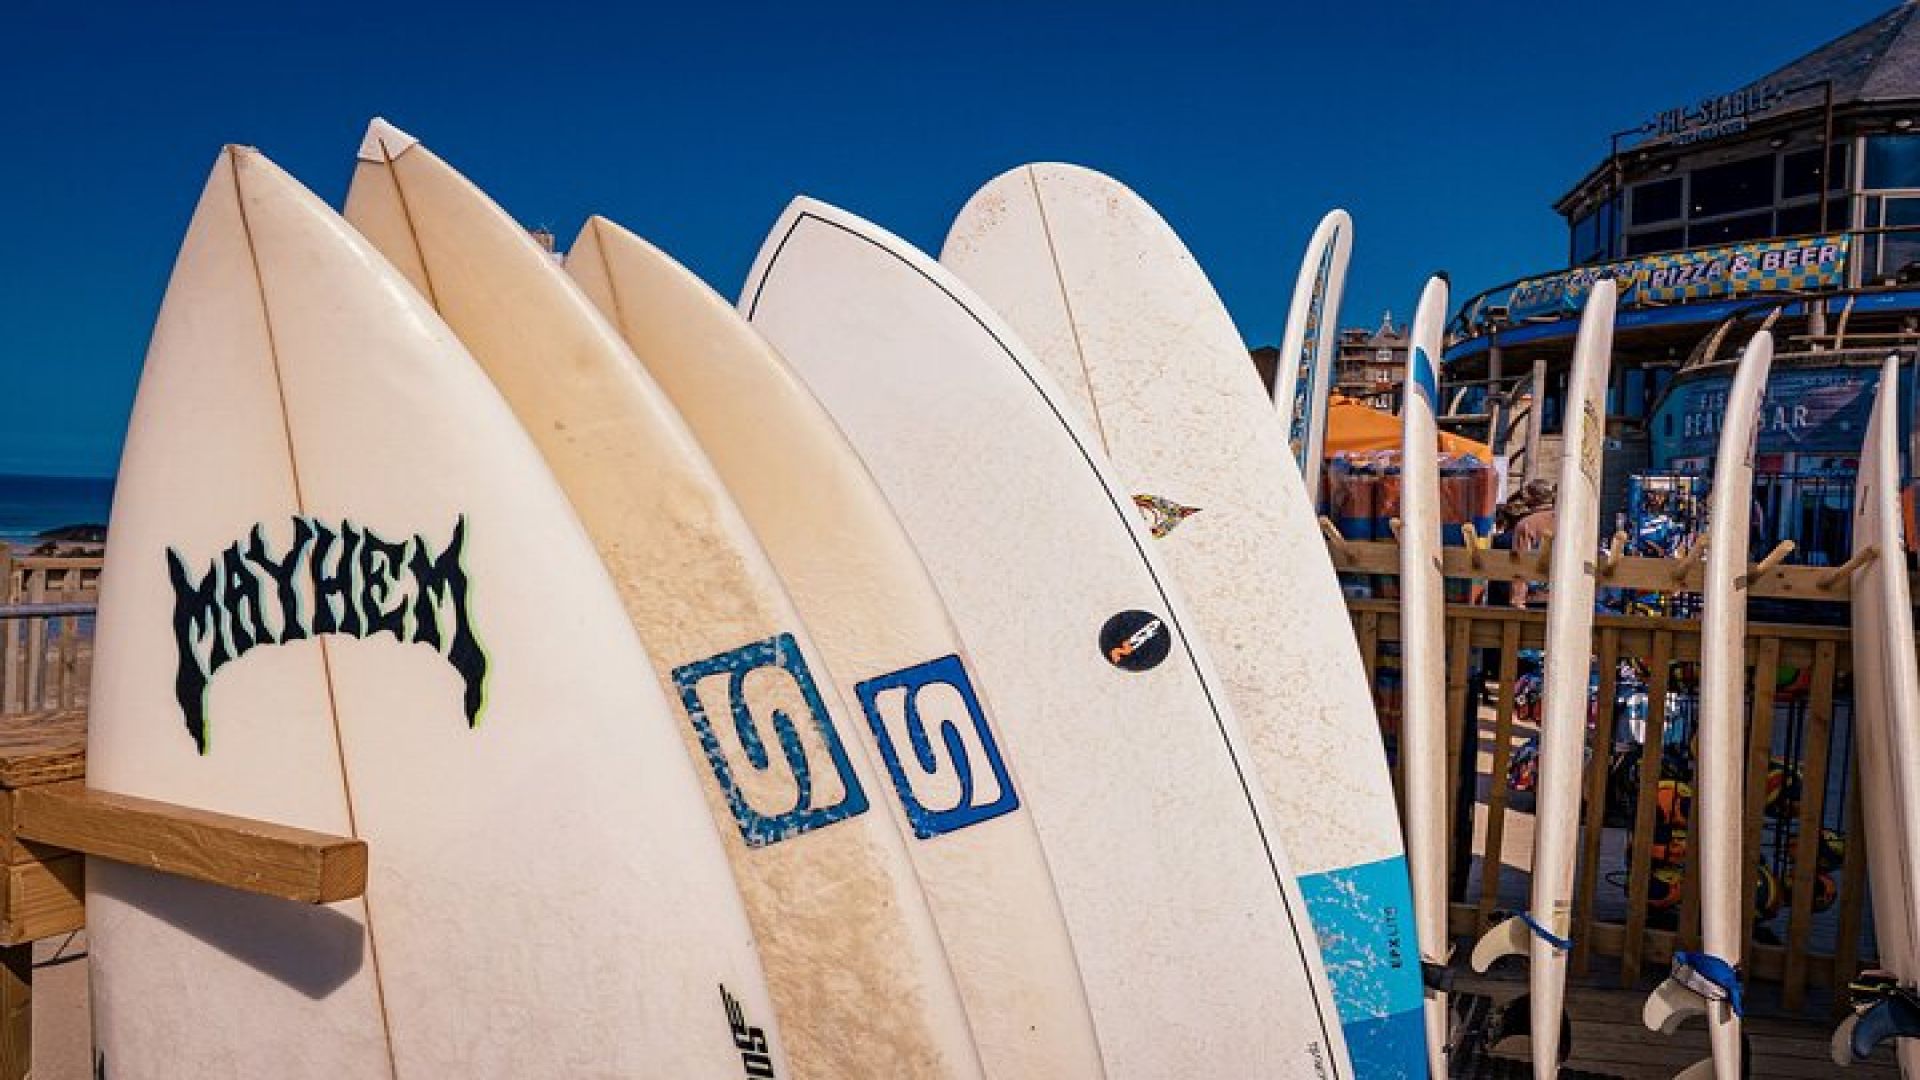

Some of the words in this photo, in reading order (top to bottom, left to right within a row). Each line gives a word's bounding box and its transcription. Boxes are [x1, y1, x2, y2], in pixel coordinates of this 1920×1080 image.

[1651, 260, 1722, 289] PIZZA
[1731, 250, 1750, 273] &
[1762, 244, 1837, 271] BEER
[166, 512, 491, 756] MAYHEM
